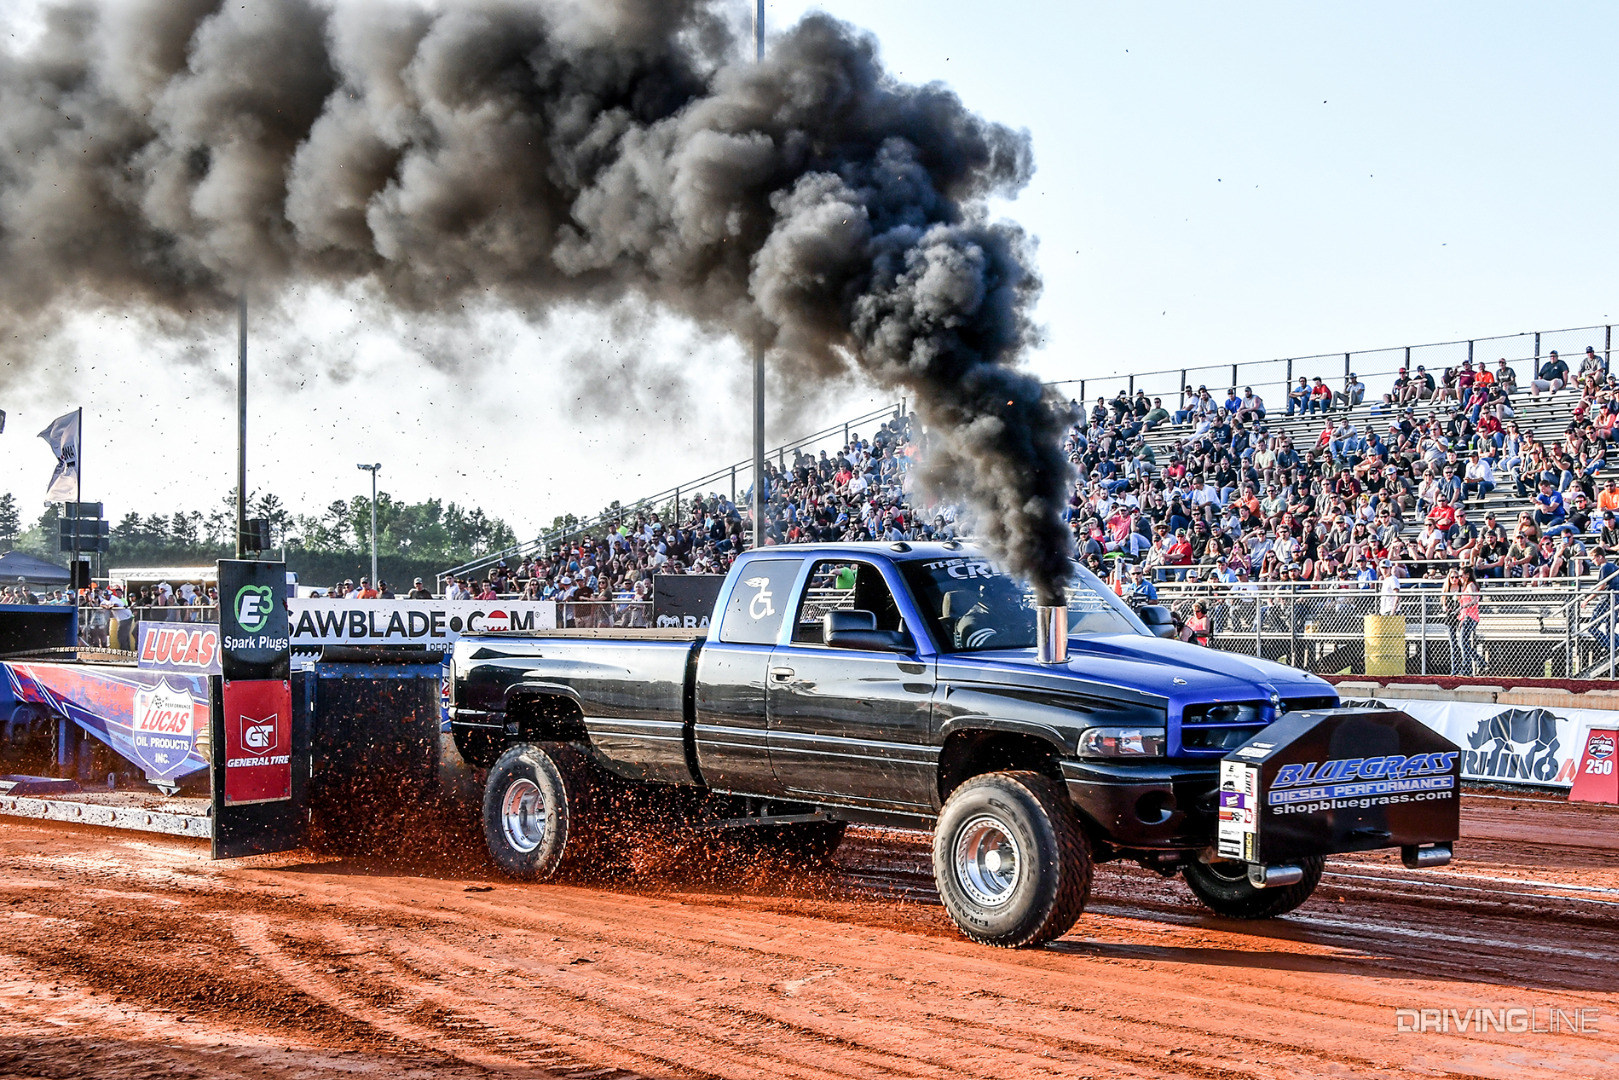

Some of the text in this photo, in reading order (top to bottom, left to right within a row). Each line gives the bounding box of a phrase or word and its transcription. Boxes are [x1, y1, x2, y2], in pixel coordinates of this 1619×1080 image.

[923, 559, 964, 570] THE
[141, 629, 218, 668] LUCAS
[224, 635, 288, 651] Spark Plugs
[140, 710, 189, 733] LUCAS
[136, 736, 189, 751] OIL PRODUCTS
[245, 725, 273, 748] GT
[155, 753, 170, 764] INC.
[227, 755, 290, 768] GENERAL TIRE
[1585, 759, 1613, 775] 250
[1269, 751, 1459, 789] BLUEGRASS
[1272, 778, 1451, 803] DIESEL PERFORMANCE
[1273, 790, 1452, 815] shopbluegrass.com
